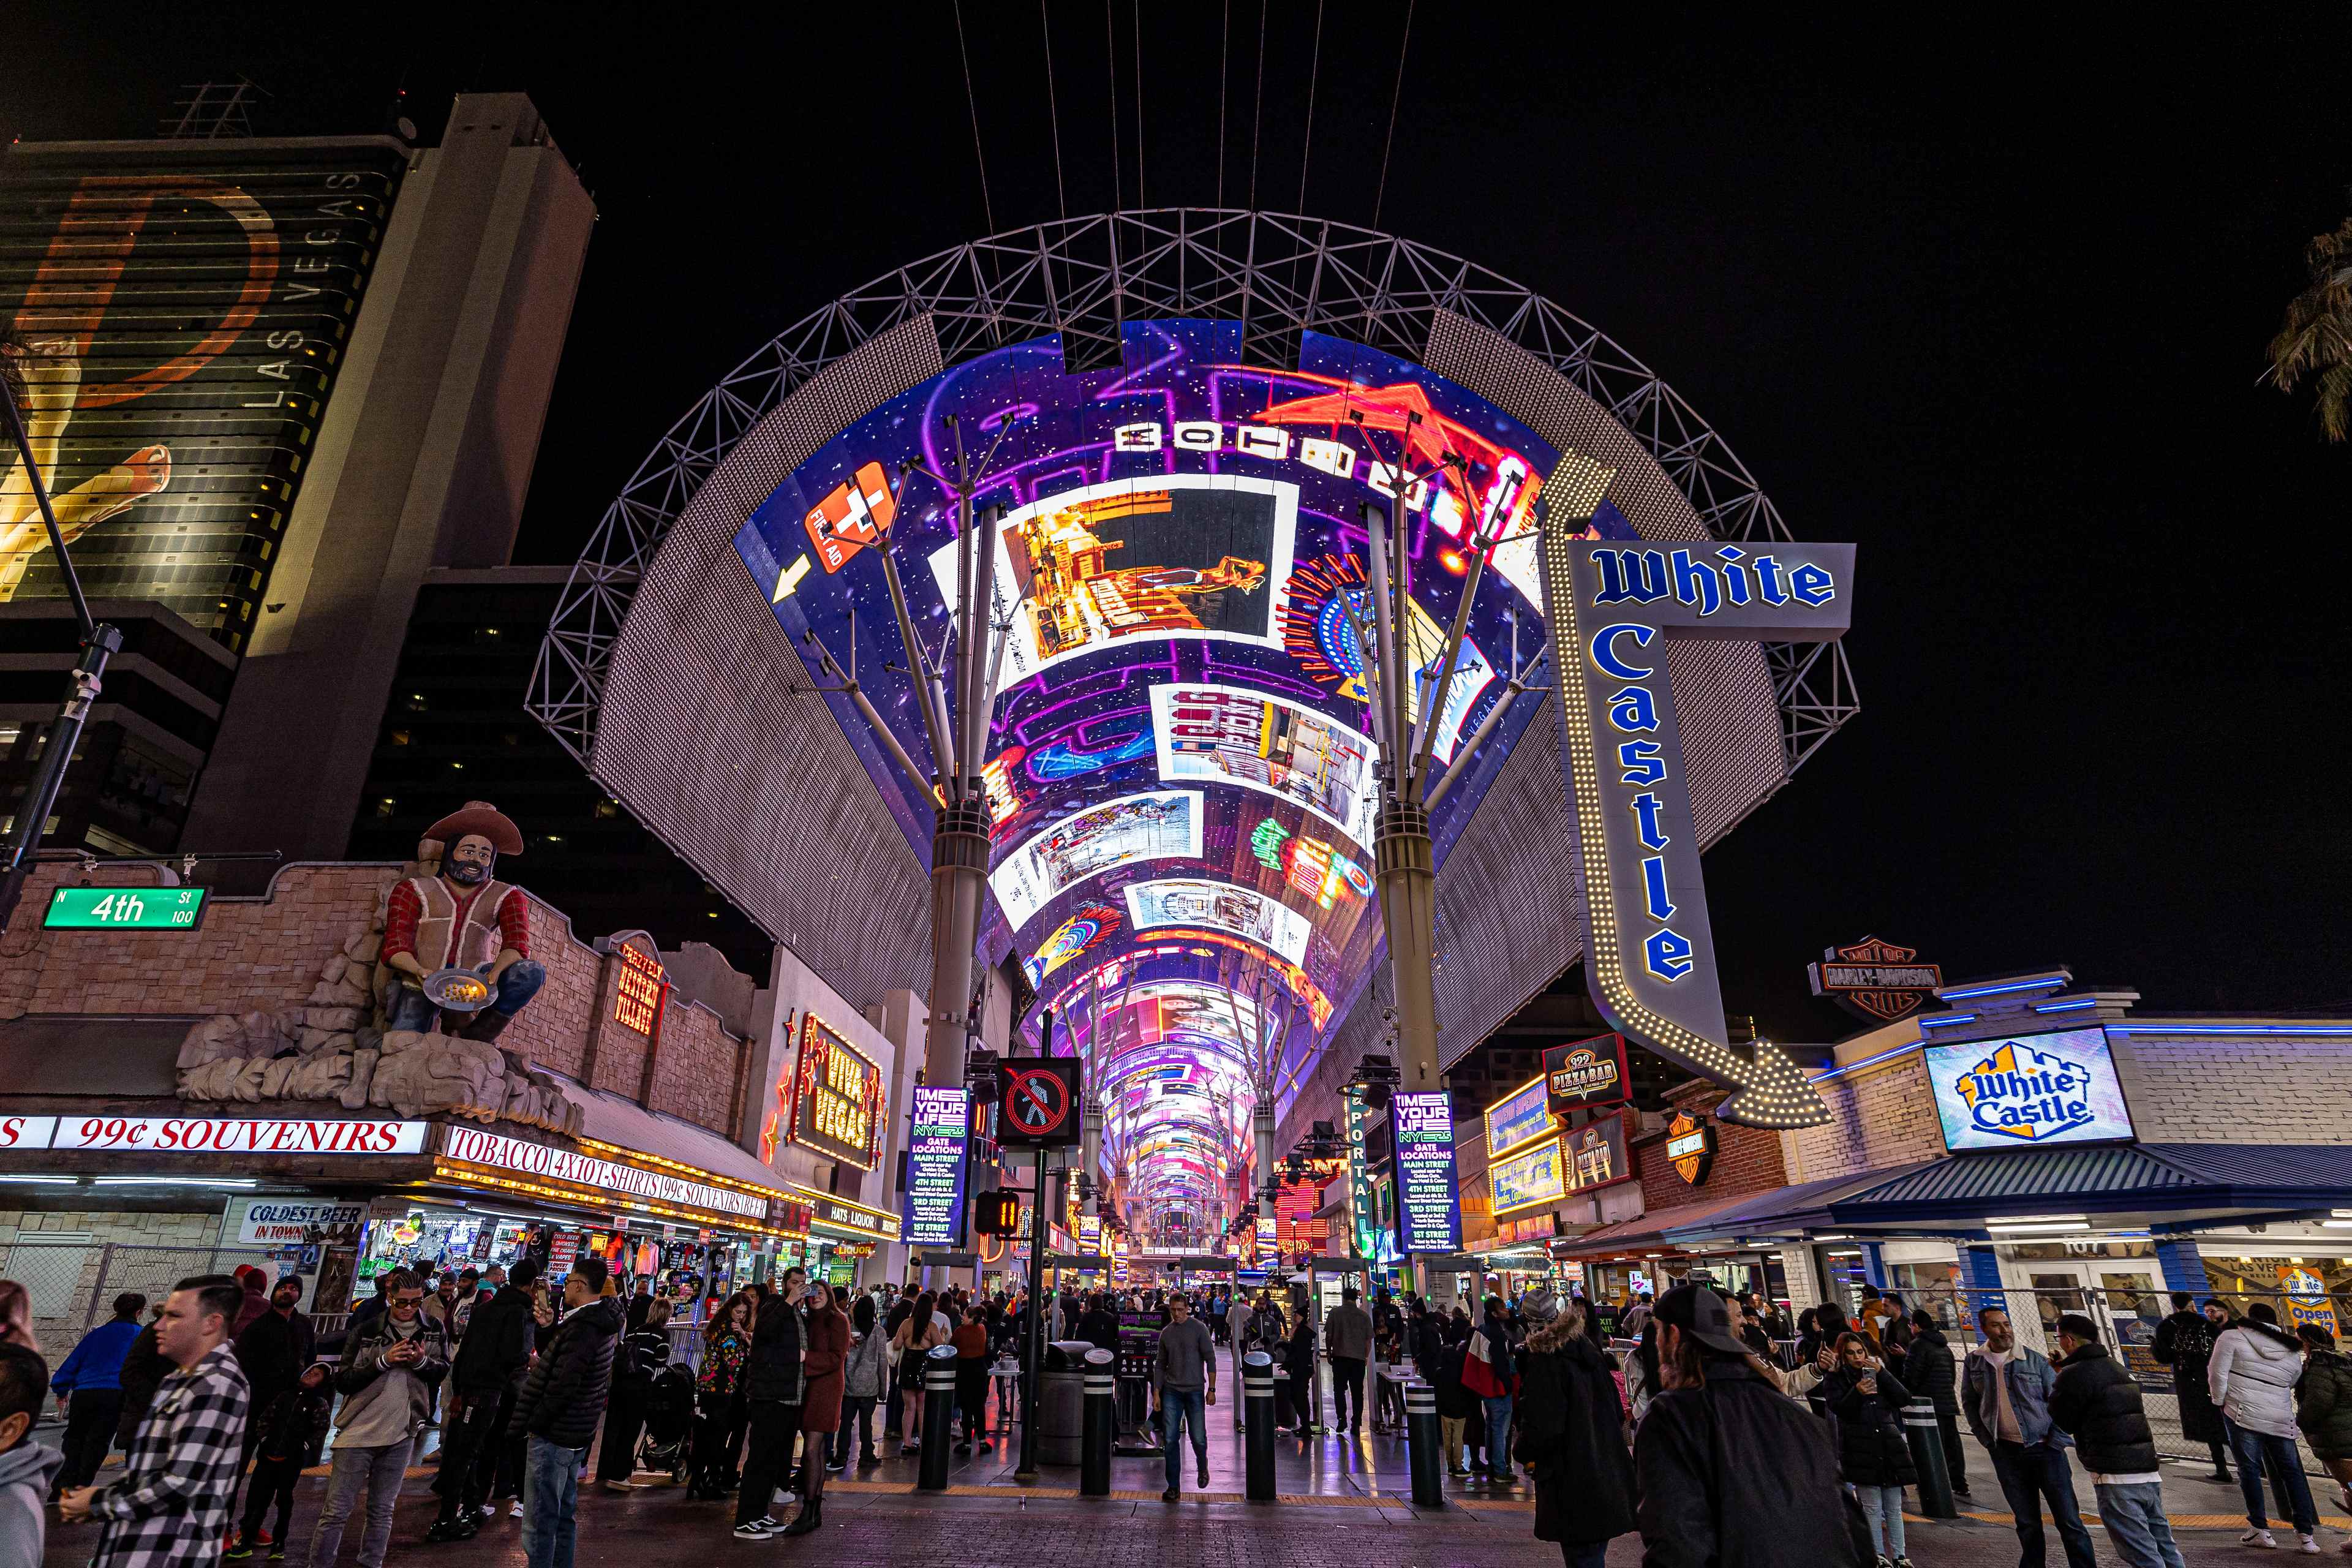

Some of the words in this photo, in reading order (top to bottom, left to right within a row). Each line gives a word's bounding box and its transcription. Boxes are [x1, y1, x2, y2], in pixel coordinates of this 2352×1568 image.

[243, 329, 304, 409] LAS
[284, 173, 361, 302] VEGAS
[825, 545, 843, 567] AID
[1590, 545, 1836, 616] White
[1088, 578, 1129, 619] PIONEER
[1590, 623, 1694, 983] Castle
[56, 892, 66, 903] N
[178, 892, 192, 904] St
[91, 894, 144, 922] 4th
[172, 911, 194, 924] 100
[1850, 948, 1905, 962] MOTOR
[1827, 967, 1937, 987] HARLEY-DAVIDSON
[618, 965, 660, 1009] WESTERN
[614, 993, 653, 1036] VILLAGE
[1570, 1054, 1591, 1070] 322
[827, 1042, 863, 1104] VIVA
[1553, 1071, 1588, 1090] PIZZA
[1588, 1065, 1613, 1082] BAR
[1973, 1068, 2078, 1102] White
[916, 1089, 962, 1102] TIME
[1395, 1094, 1442, 1107] TIME
[915, 1101, 967, 1114] YOUR
[1396, 1107, 1450, 1119] YOUR
[1972, 1096, 2091, 1130] Castle
[815, 1085, 867, 1150] VEGAS
[914, 1113, 966, 1126] LIFE
[1398, 1118, 1451, 1131] LIFE
[80, 1118, 148, 1149] 99¢
[154, 1119, 402, 1152] SOUVENIRS
[913, 1125, 965, 1137] NYE25
[1399, 1131, 1452, 1143] NYE25
[927, 1137, 949, 1146] GATE
[451, 1128, 549, 1174] TOBACCO
[912, 1145, 963, 1155] LOCATIONS
[1400, 1152, 1452, 1160] LOCATIONS
[1594, 1146, 1610, 1163] BAR
[1351, 1112, 1367, 1215] PORTAL
[554, 1152, 598, 1186] 4X10
[595, 1163, 660, 1198] T-SHIRTS
[685, 1183, 741, 1214] SOUVENIRS
[743, 1194, 767, 1219] BEER
[249, 1205, 319, 1224] COLDEST
[318, 1205, 362, 1224] BEER
[831, 1205, 848, 1223] HATS
[851, 1211, 875, 1229] LIQUOR
[254, 1225, 268, 1240] IN
[270, 1225, 304, 1240] TOWN
[839, 1245, 872, 1256] LIQUOR
[831, 1257, 854, 1265] EDIBLES
[2230, 1263, 2255, 1272] LAS
[829, 1274, 853, 1284] VAPE
[1600, 1317, 1613, 1326] XIT
[2292, 1306, 2334, 1322] Open
